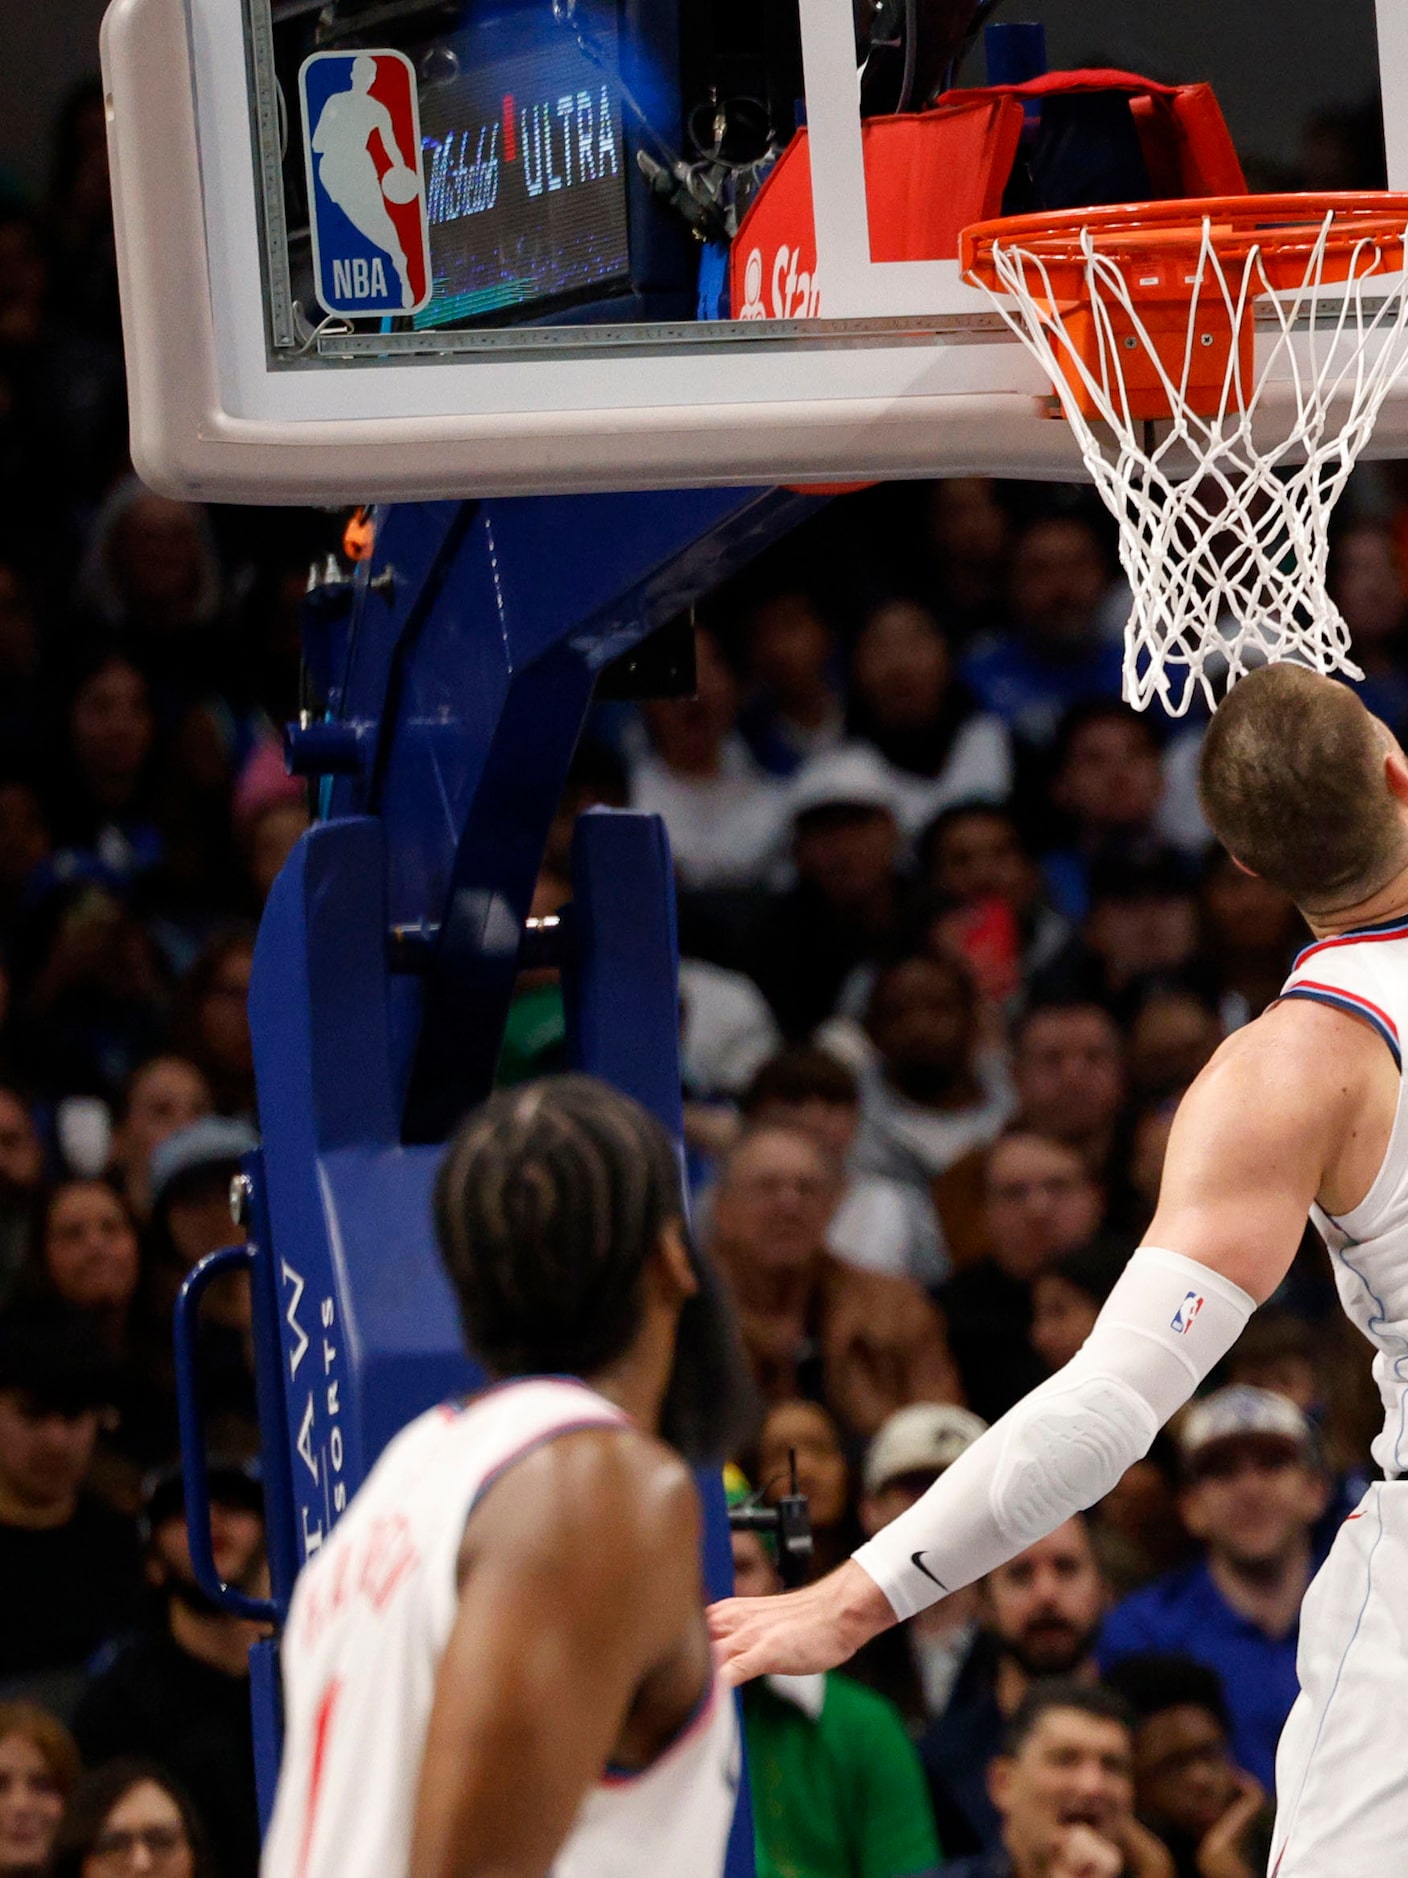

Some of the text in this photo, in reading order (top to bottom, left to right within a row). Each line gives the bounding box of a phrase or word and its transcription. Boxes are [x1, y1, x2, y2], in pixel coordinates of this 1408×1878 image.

[521, 85, 618, 198] ULTRA
[332, 257, 388, 300] NBA
[320, 1296, 347, 1513] SORTS
